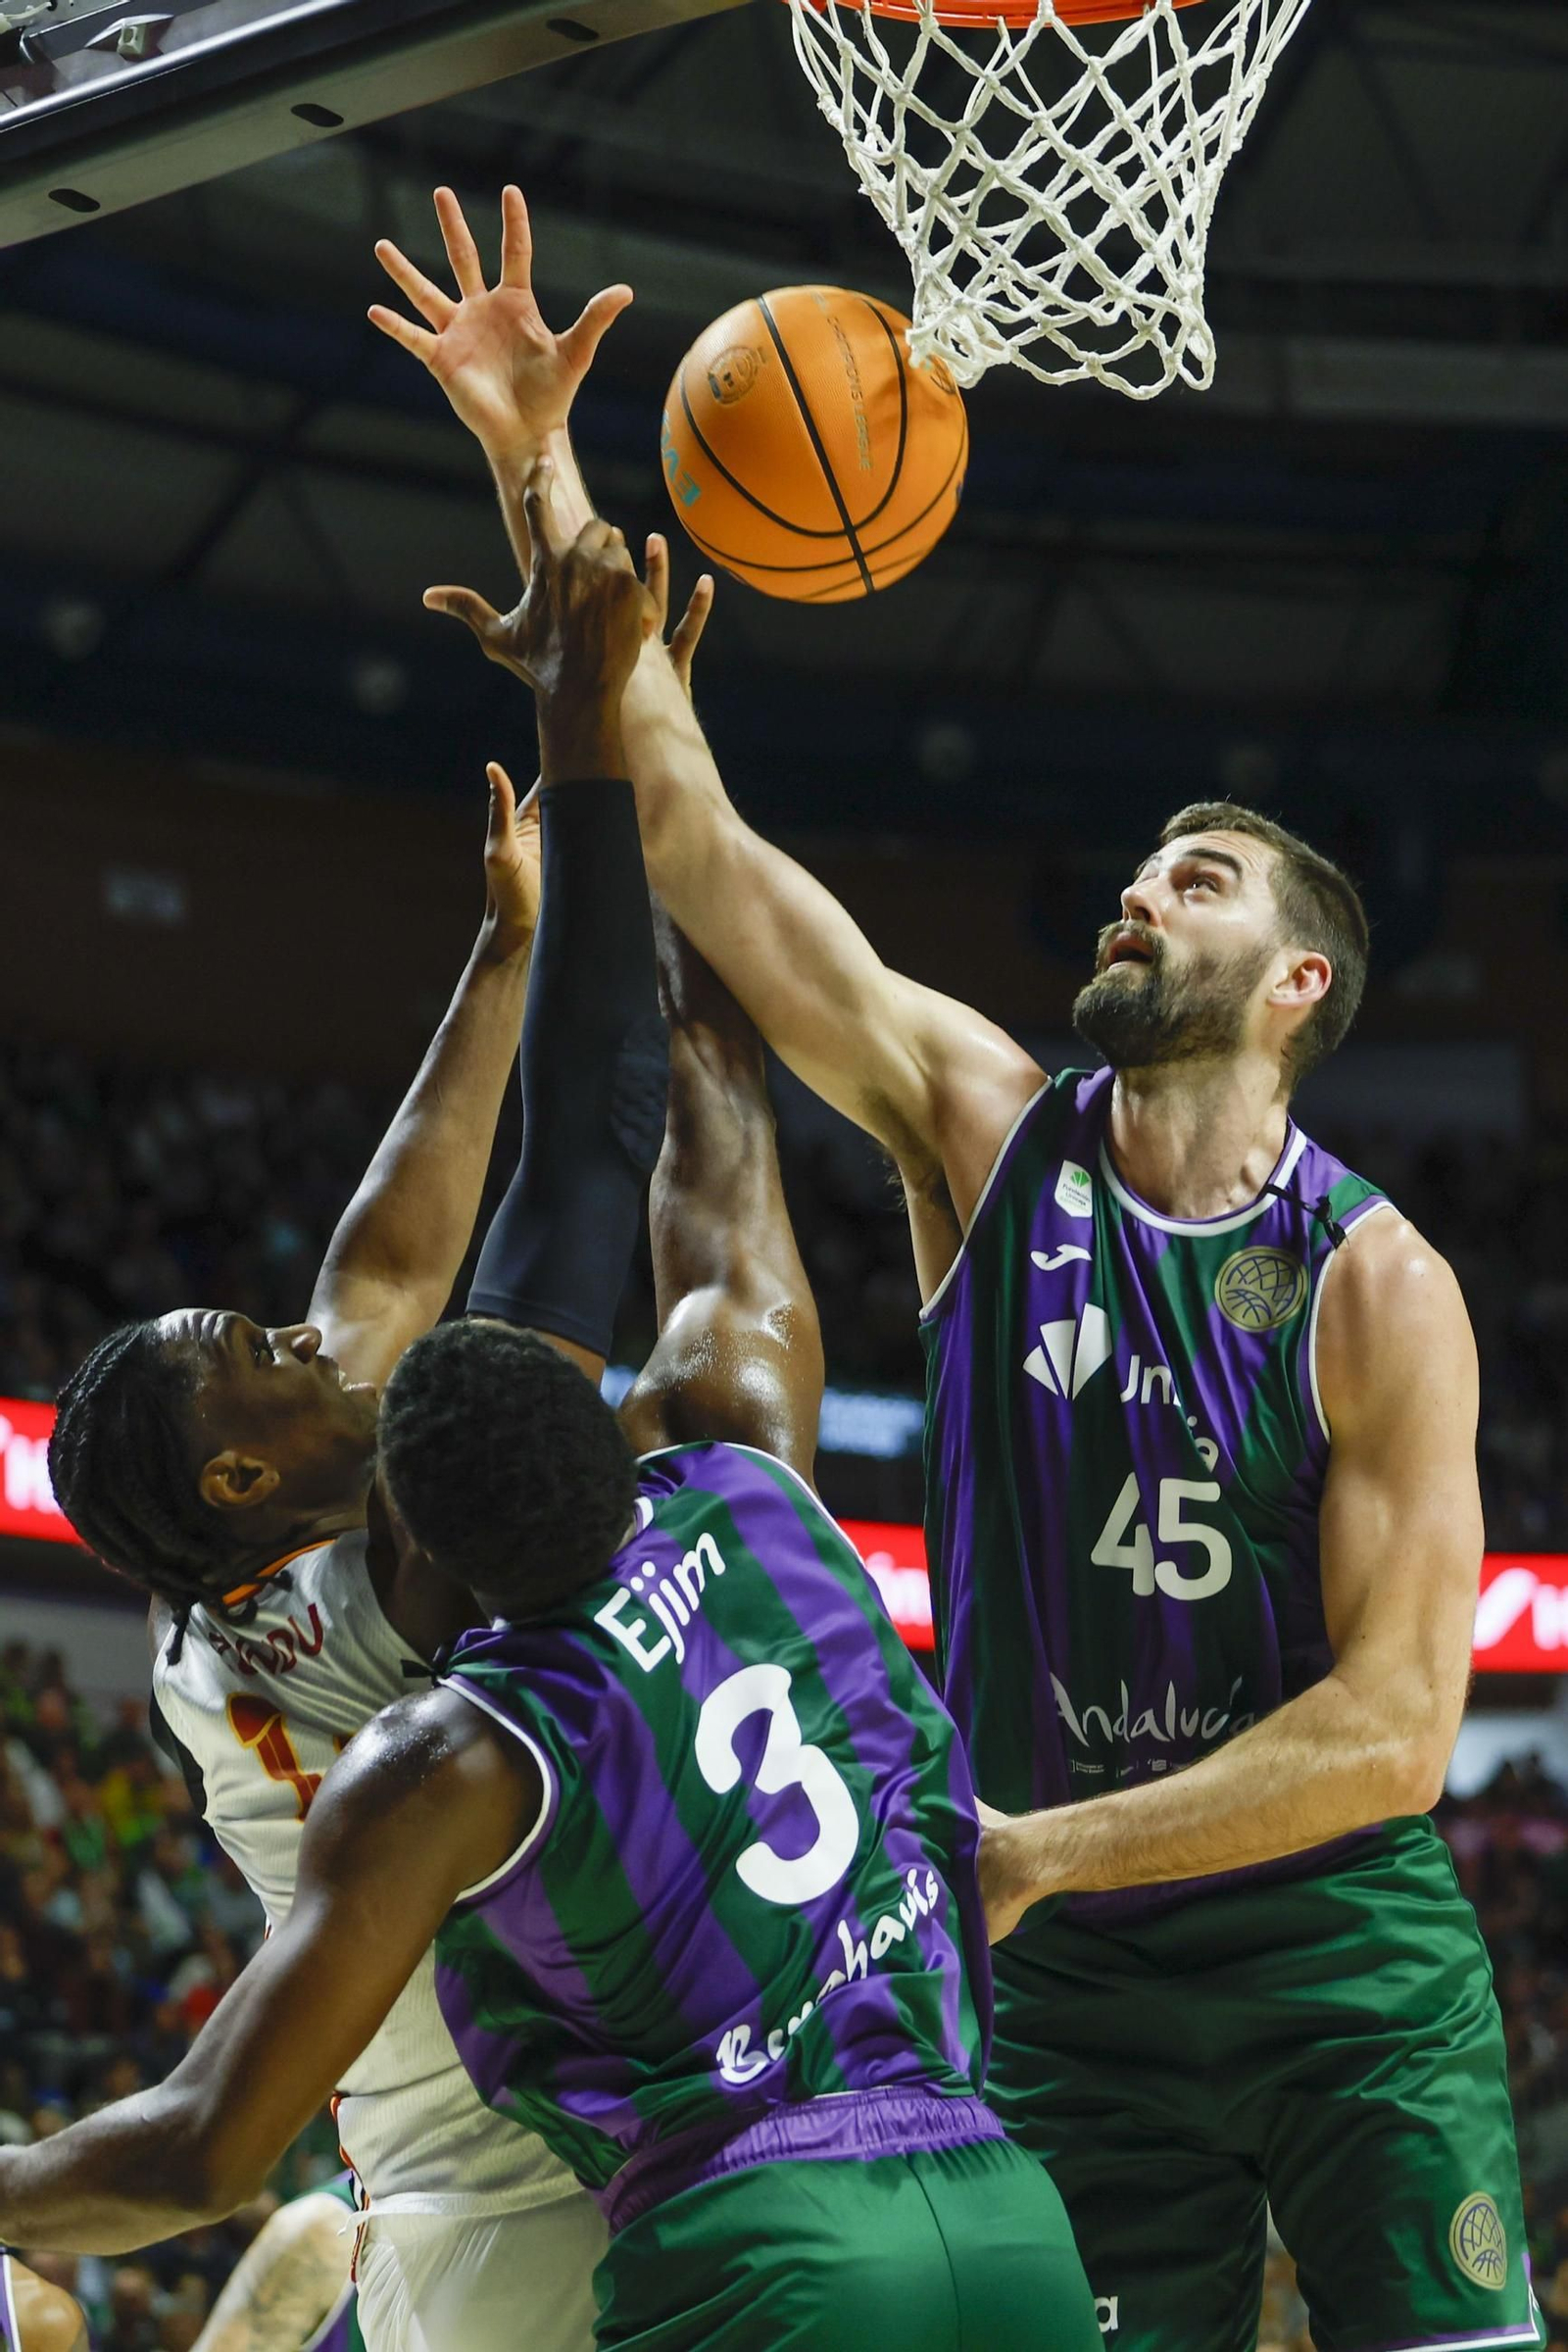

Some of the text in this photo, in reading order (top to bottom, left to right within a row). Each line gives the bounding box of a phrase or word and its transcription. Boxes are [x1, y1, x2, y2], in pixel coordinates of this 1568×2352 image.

[594, 1532, 727, 1673] Ejim
[1090, 1471, 1233, 1601] 45
[694, 1663, 859, 1905] 3
